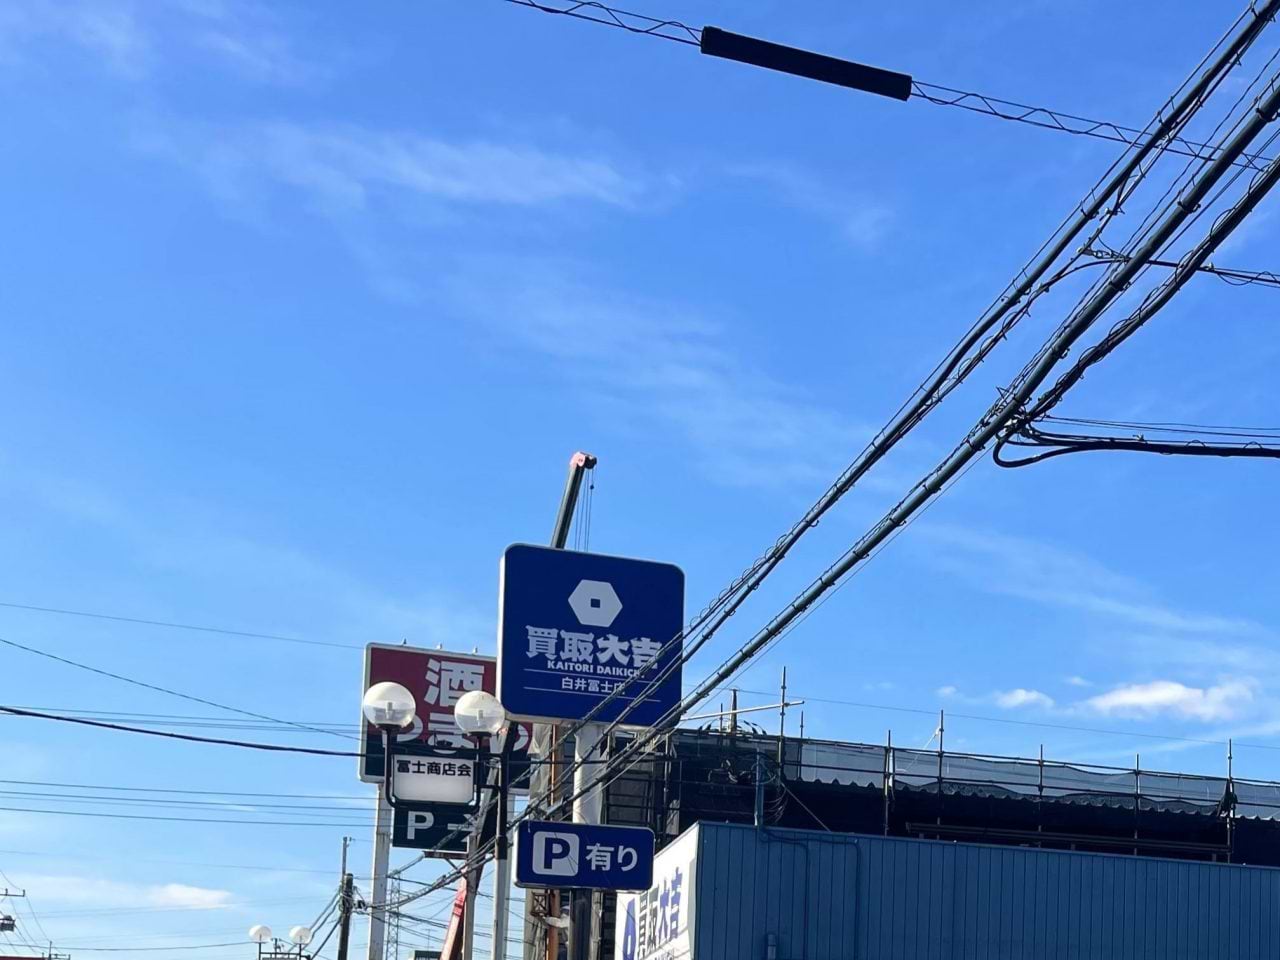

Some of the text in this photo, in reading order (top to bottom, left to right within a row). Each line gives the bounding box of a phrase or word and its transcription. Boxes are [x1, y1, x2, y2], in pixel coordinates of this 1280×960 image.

[525, 625, 662, 669] 買取大吉
[424, 658, 485, 707] 酒
[547, 660, 645, 678] KAITORI DAIKICH
[407, 810, 434, 840] P
[543, 837, 638, 872] P 有り
[638, 866, 682, 960] 買取大吉
